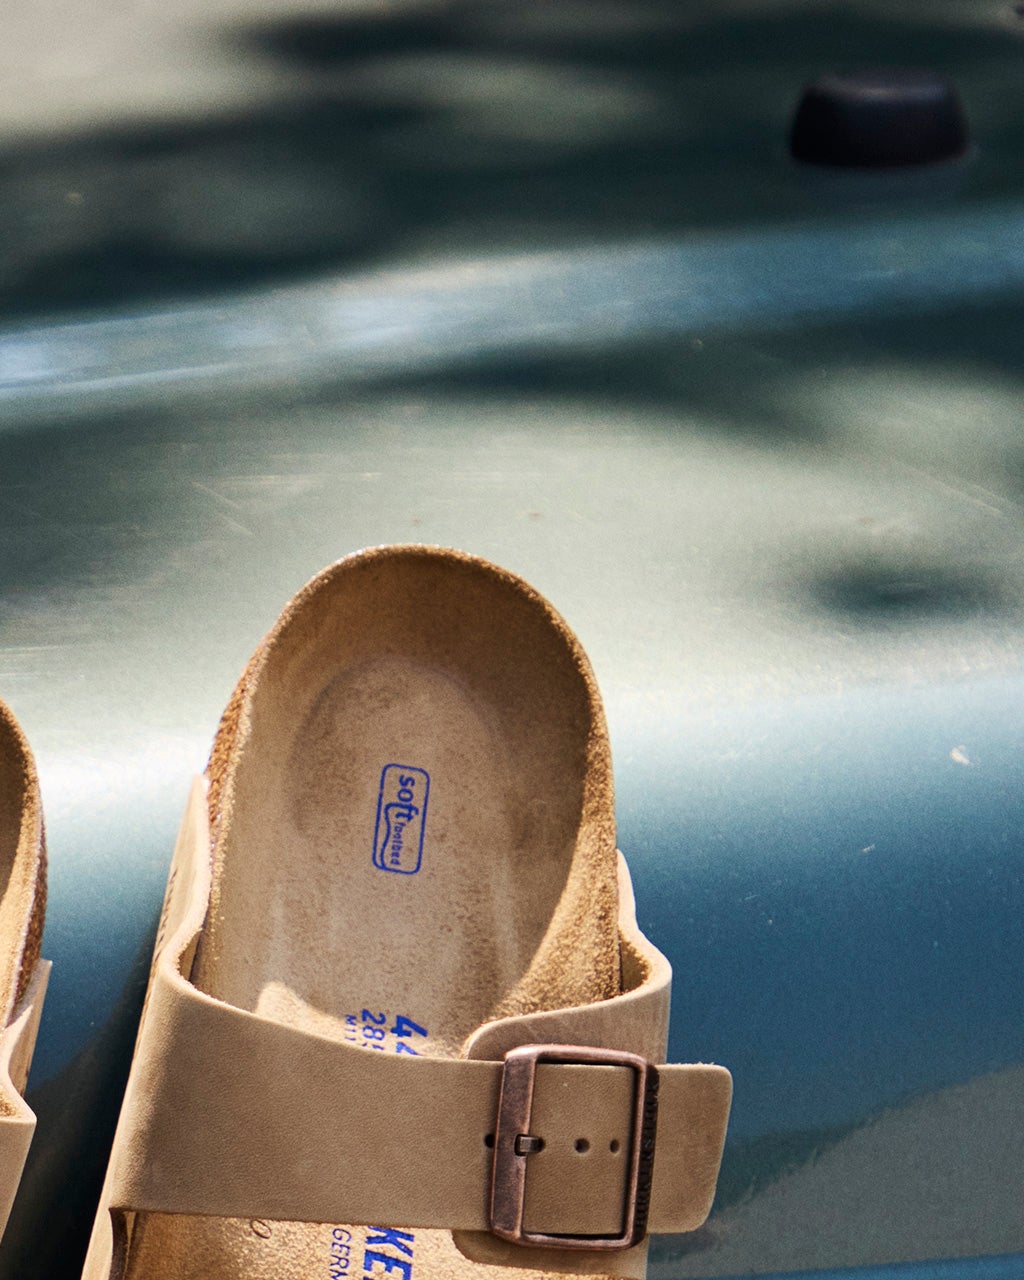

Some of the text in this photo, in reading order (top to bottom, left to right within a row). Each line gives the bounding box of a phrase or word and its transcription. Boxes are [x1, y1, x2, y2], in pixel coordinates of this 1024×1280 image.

[387, 774, 419, 866] soft footbed
[361, 1008, 386, 1051] 28
